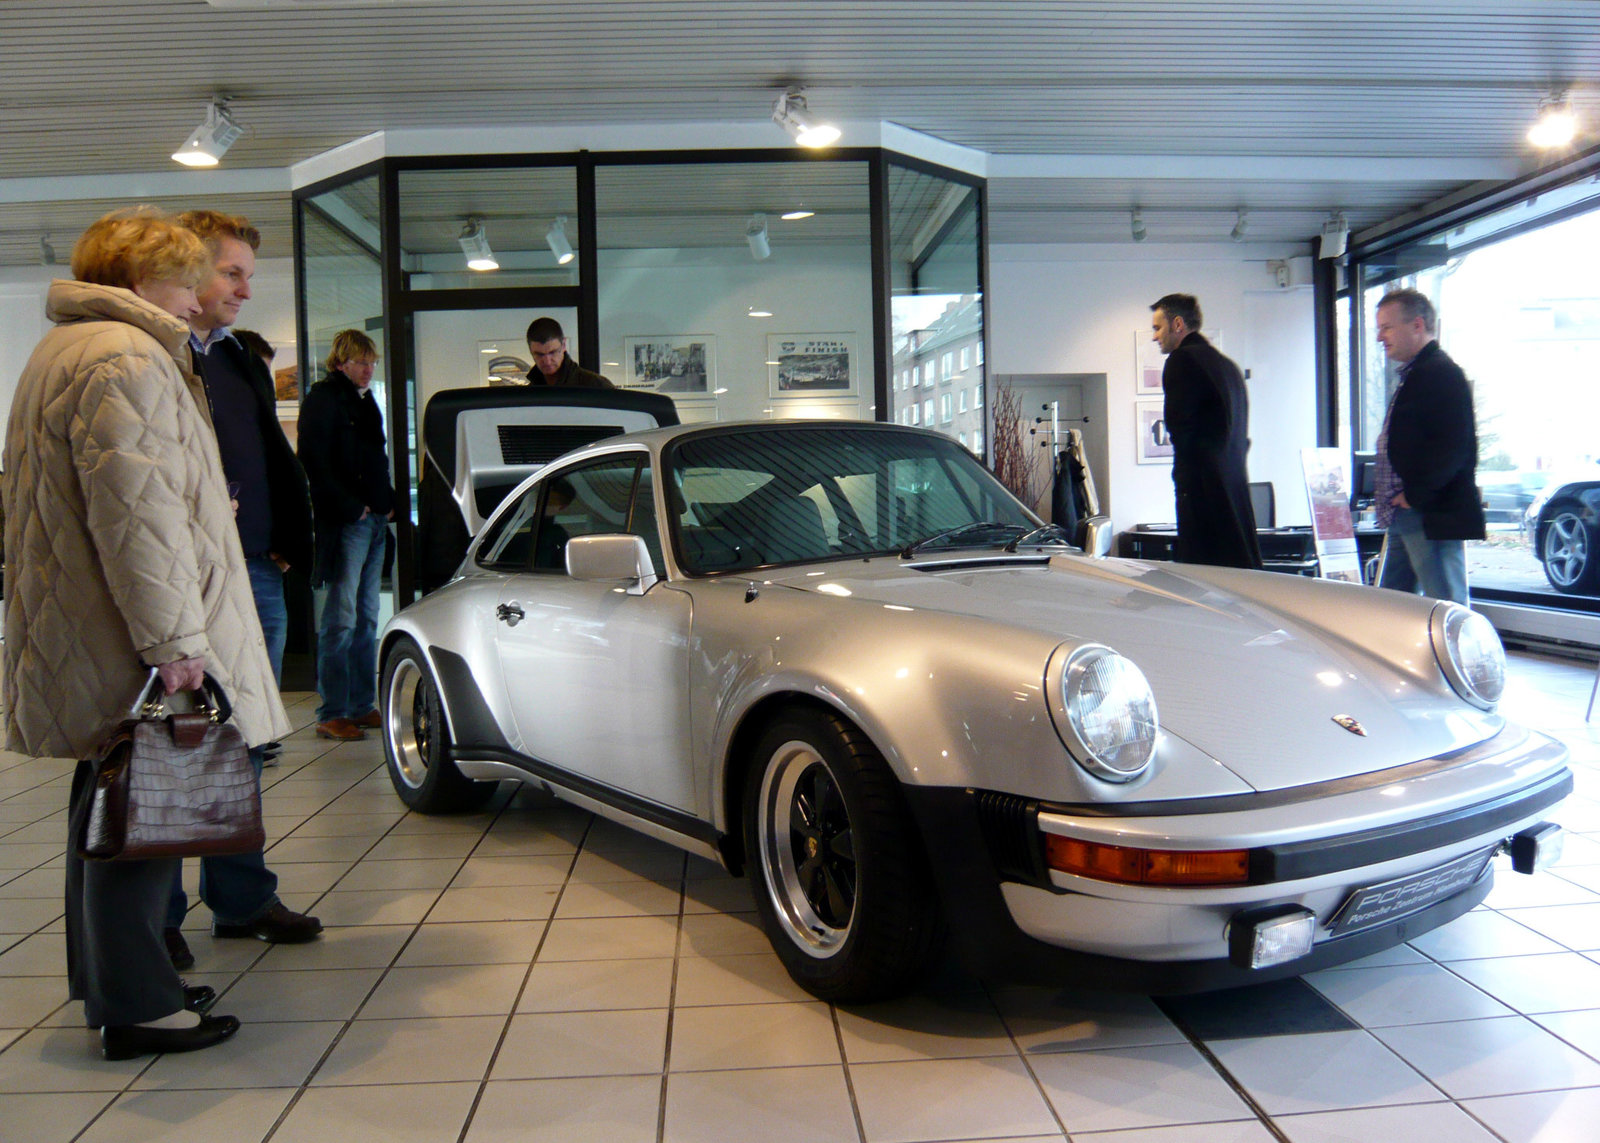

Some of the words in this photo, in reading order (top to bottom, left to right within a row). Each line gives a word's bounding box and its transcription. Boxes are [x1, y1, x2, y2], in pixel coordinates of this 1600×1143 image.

[1356, 855, 1487, 911] PORSCHE
[1347, 906, 1392, 925] Porsche
[1393, 891, 1434, 911] Zentrum
